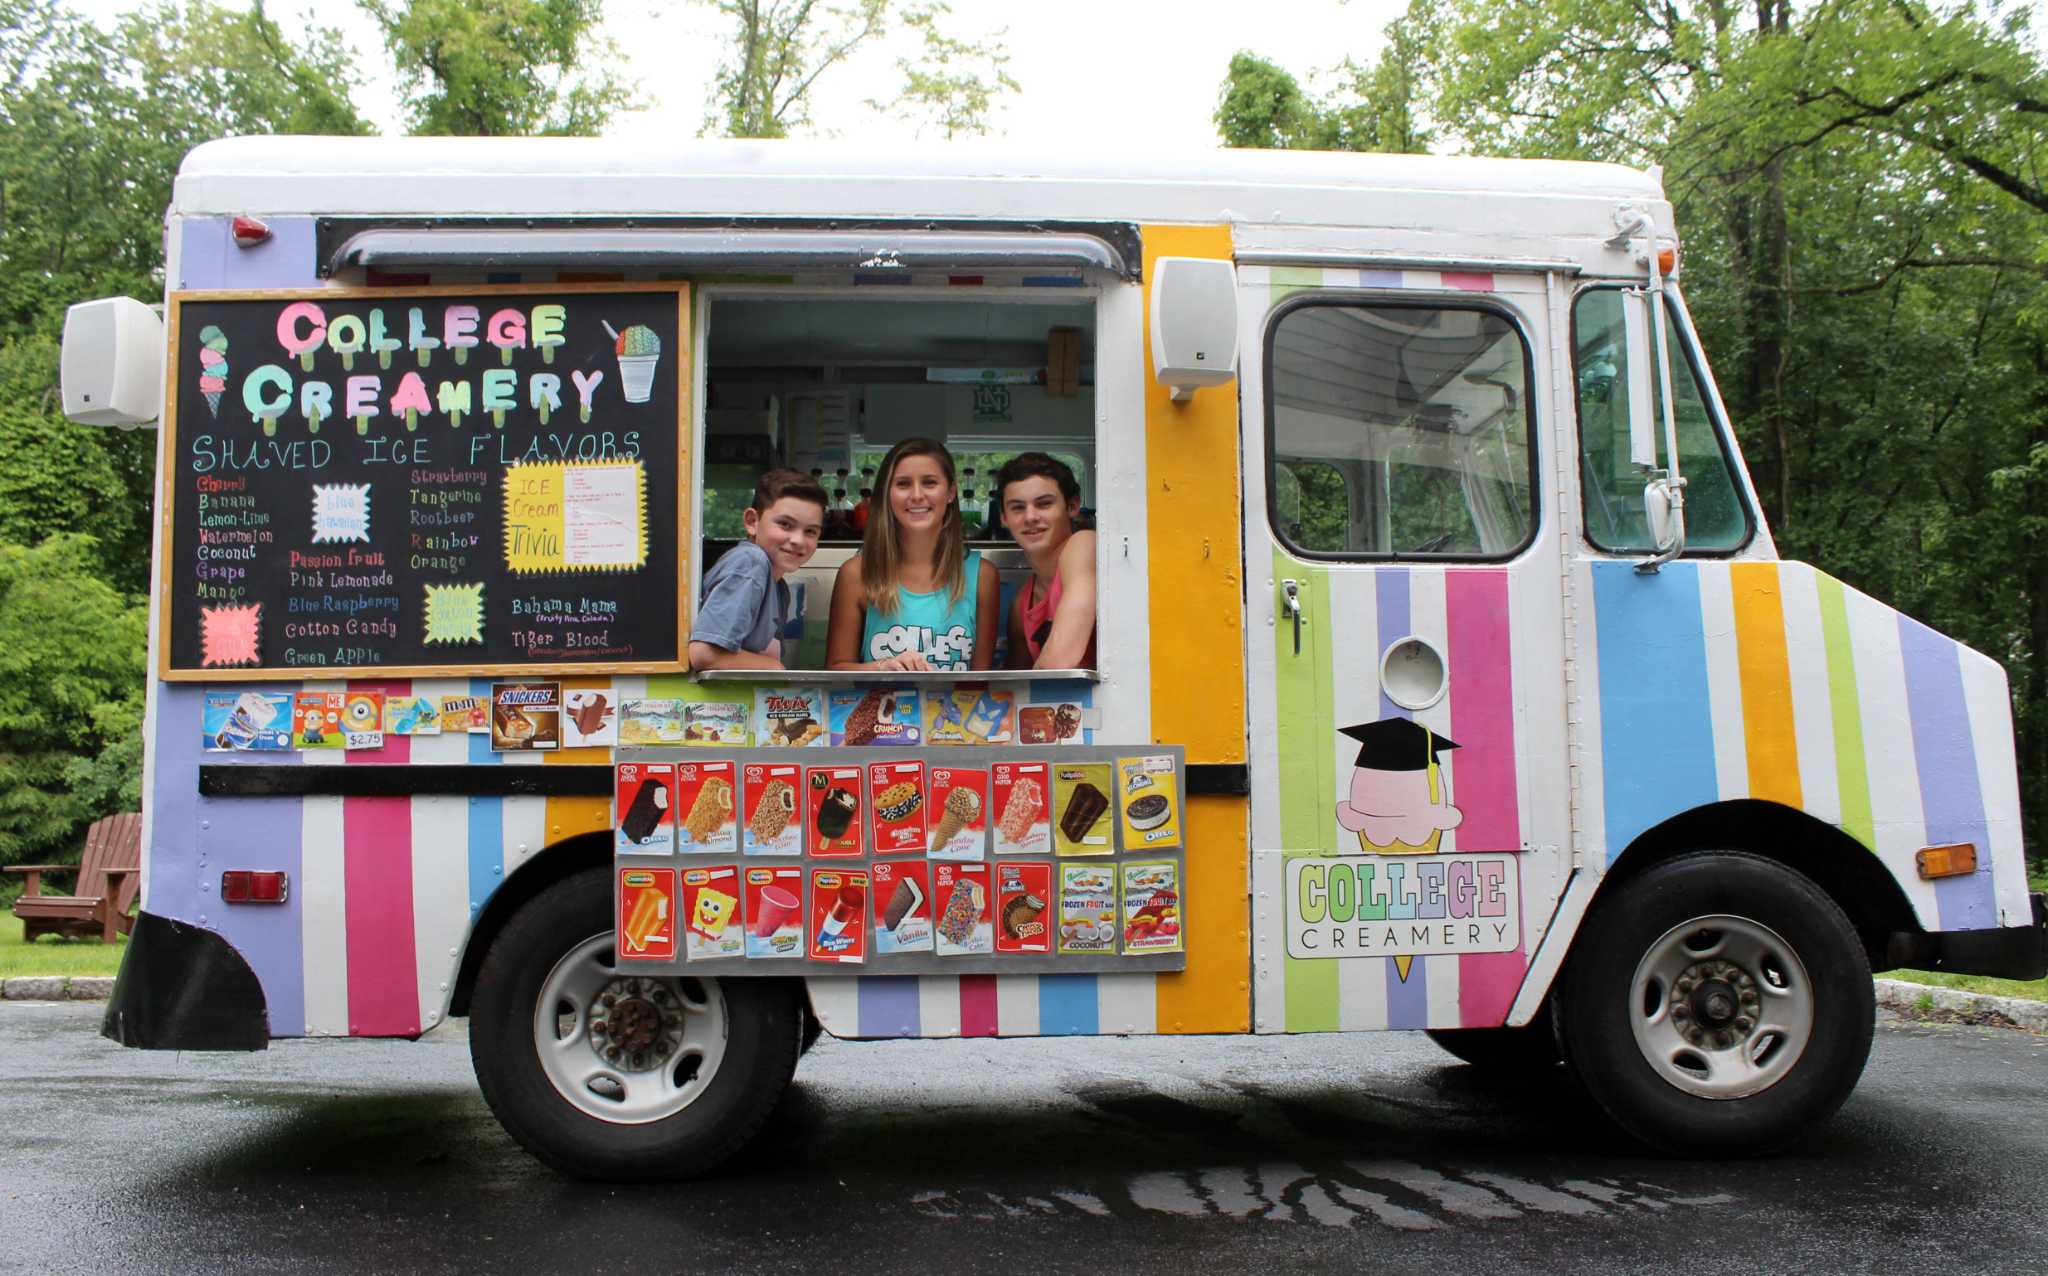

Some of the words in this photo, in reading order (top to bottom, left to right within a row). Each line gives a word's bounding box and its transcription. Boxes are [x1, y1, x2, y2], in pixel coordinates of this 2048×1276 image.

[277, 301, 566, 367] COLLEGE
[243, 364, 603, 432] CREAMERY
[193, 435, 331, 472] SHAVED
[364, 438, 432, 464] ICE
[471, 431, 641, 466] FLAVORS
[196, 475, 246, 492] Cherry
[410, 468, 488, 486] Strawberry
[520, 479, 551, 495] ICE
[199, 494, 255, 509] Banana
[409, 489, 481, 509] Tangerine
[410, 509, 475, 526] Rootbeer
[513, 499, 559, 518] Cream
[199, 528, 273, 544] Watermelon
[411, 532, 479, 550] Rainbow
[511, 525, 560, 557] Trivia
[197, 545, 256, 561] Coconut
[290, 550, 342, 568] Passion
[196, 561, 245, 584] Grape
[410, 554, 466, 574] Orange
[290, 571, 324, 587] Pink
[330, 570, 393, 588] Lemonade
[196, 582, 246, 600] Mango
[288, 598, 320, 613] Blue
[323, 594, 400, 617] Raspberry
[512, 596, 572, 615] Bahama
[580, 597, 617, 615] Mama
[285, 622, 340, 639] Cotton
[346, 618, 397, 639] Candy
[512, 630, 554, 649] Tiger
[566, 629, 609, 647] Blood
[285, 648, 327, 665] Green
[500, 690, 552, 704] SNICKERS
[350, 734, 381, 746] $2.75
[1145, 829, 1176, 842] OREO
[1299, 860, 1507, 924] COLLEGE
[896, 930, 929, 944] Vanilla
[1301, 923, 1507, 950] CREAMERY
[1069, 942, 1105, 950] COCONUT
